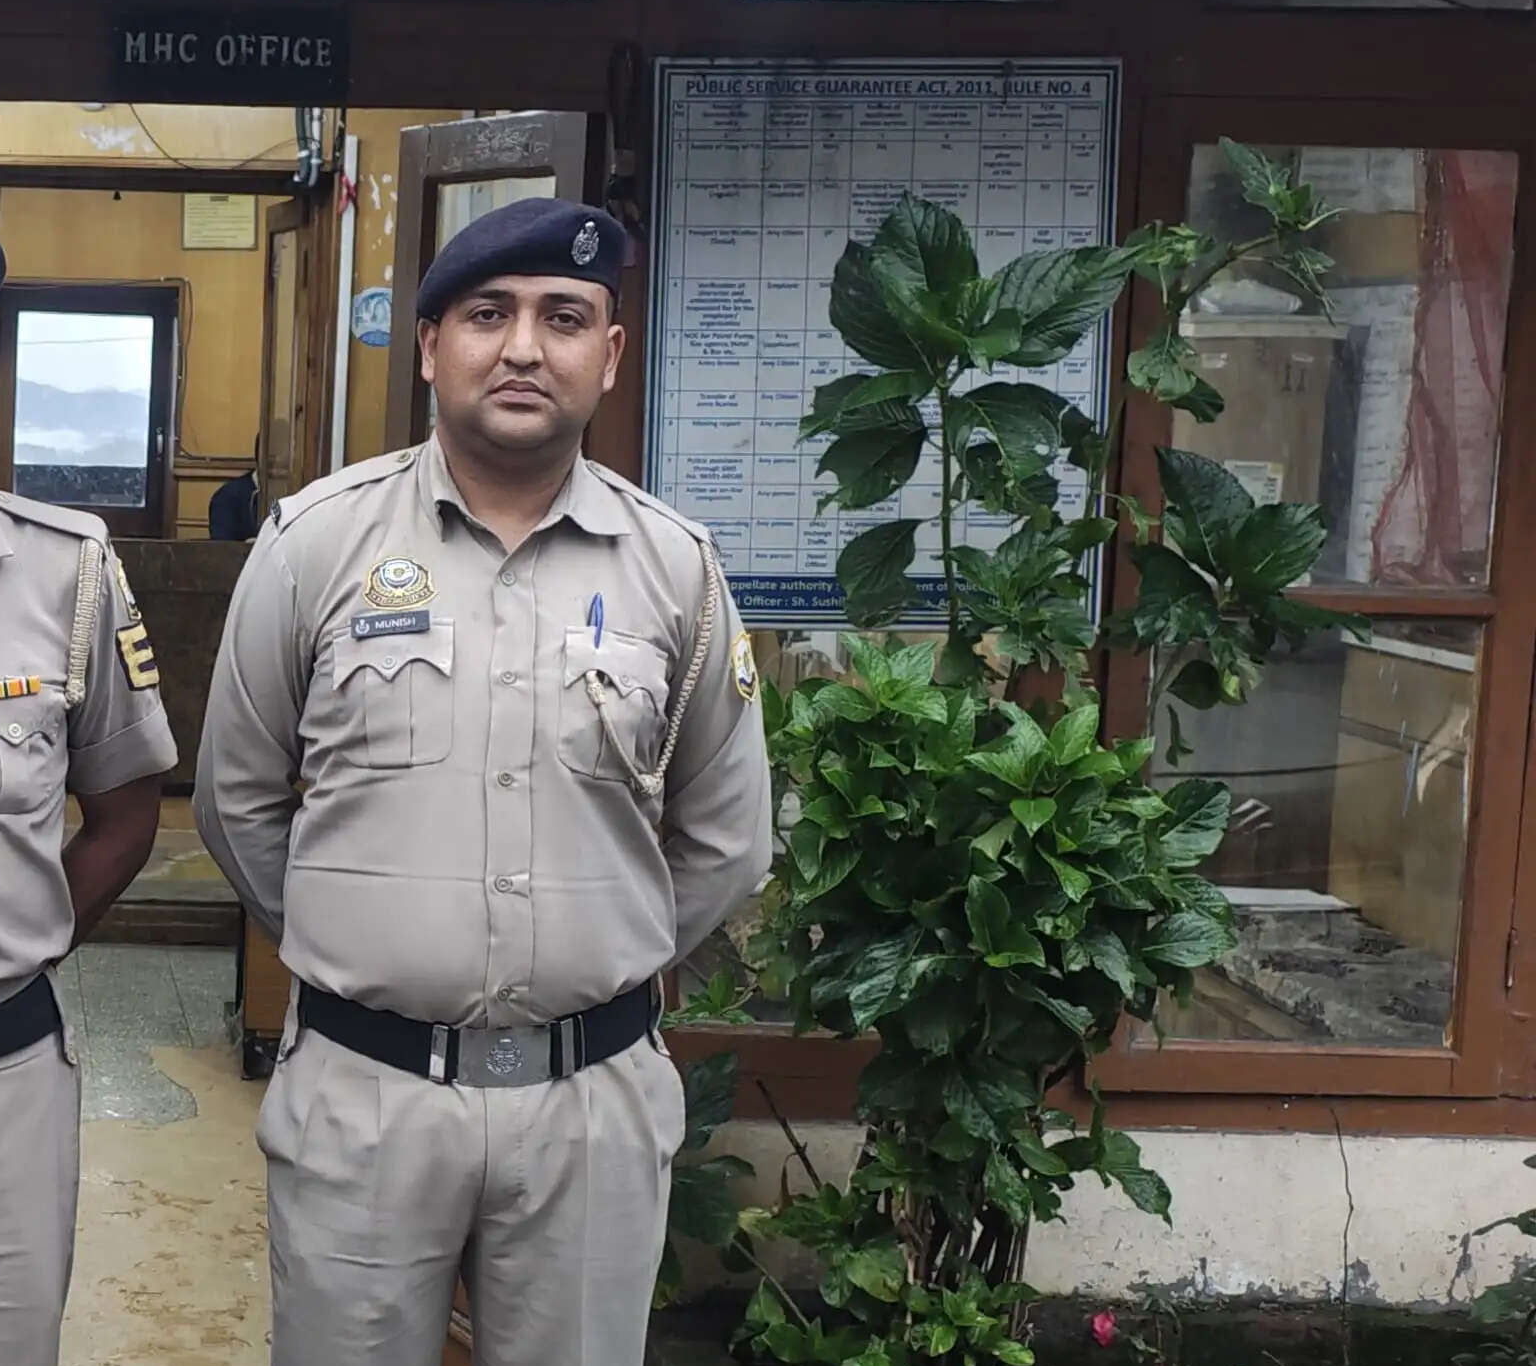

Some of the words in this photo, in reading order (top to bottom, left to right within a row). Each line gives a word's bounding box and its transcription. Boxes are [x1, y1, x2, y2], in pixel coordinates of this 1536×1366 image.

[124, 31, 198, 64] MHC
[215, 34, 332, 67] OFFICE
[686, 79, 742, 95] PUBLIC
[745, 79, 810, 95] SERVICE
[814, 79, 913, 95] GUARANTEE
[916, 79, 951, 97] ACT,
[1047, 79, 1077, 95] NO.
[1081, 79, 1092, 95] 4
[729, 578, 777, 592] ppellate
[779, 578, 833, 592] authority
[375, 616, 416, 630] MUNISH
